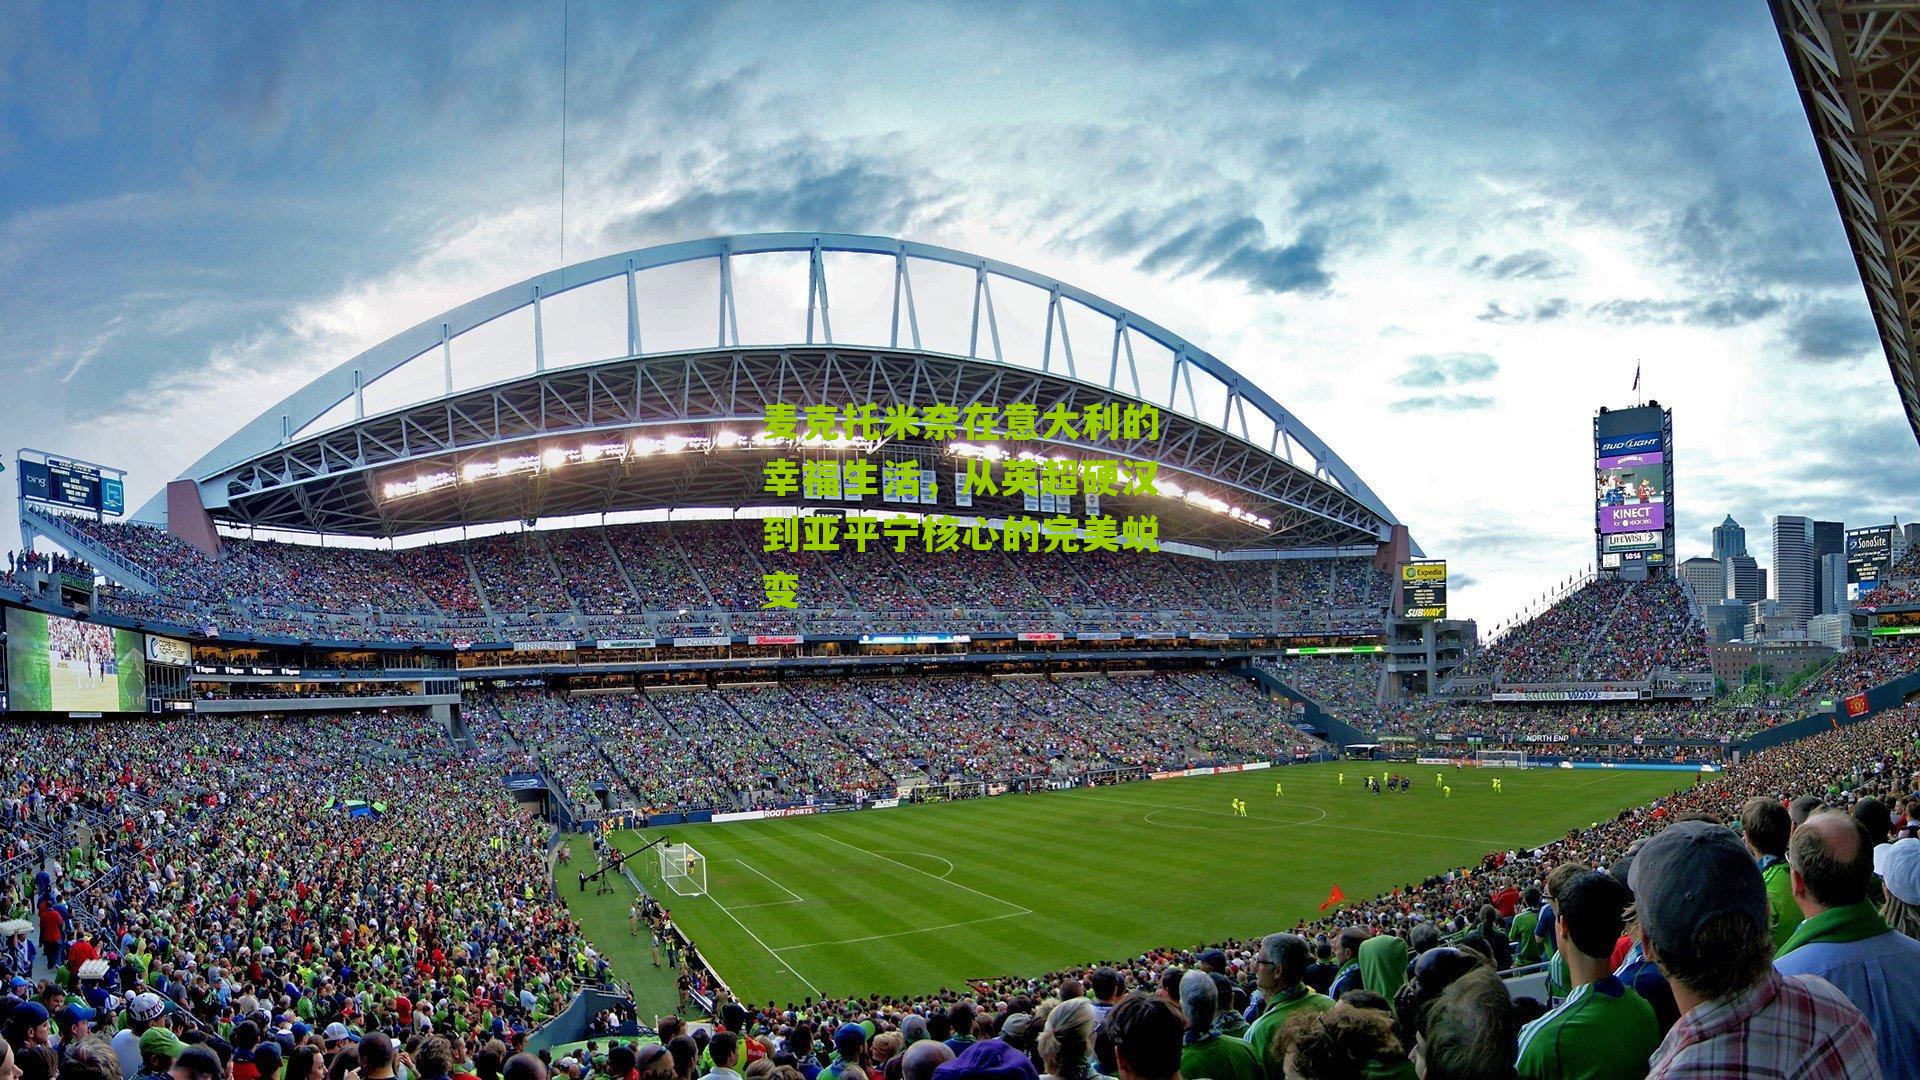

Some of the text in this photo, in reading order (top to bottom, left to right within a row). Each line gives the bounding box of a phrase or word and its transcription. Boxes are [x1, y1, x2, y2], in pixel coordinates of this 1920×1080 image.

[1602, 438, 1659, 450] BUD LIGHT
[26, 474, 46, 488] bing
[1613, 507, 1653, 520] KINECT
[1858, 535, 1887, 549] SonoSite
[1416, 569, 1442, 577] Expedia
[1405, 608, 1445, 618] SUBWAY
[1526, 734, 1569, 742] NORTH END
[764, 808, 786, 818] ROOT
